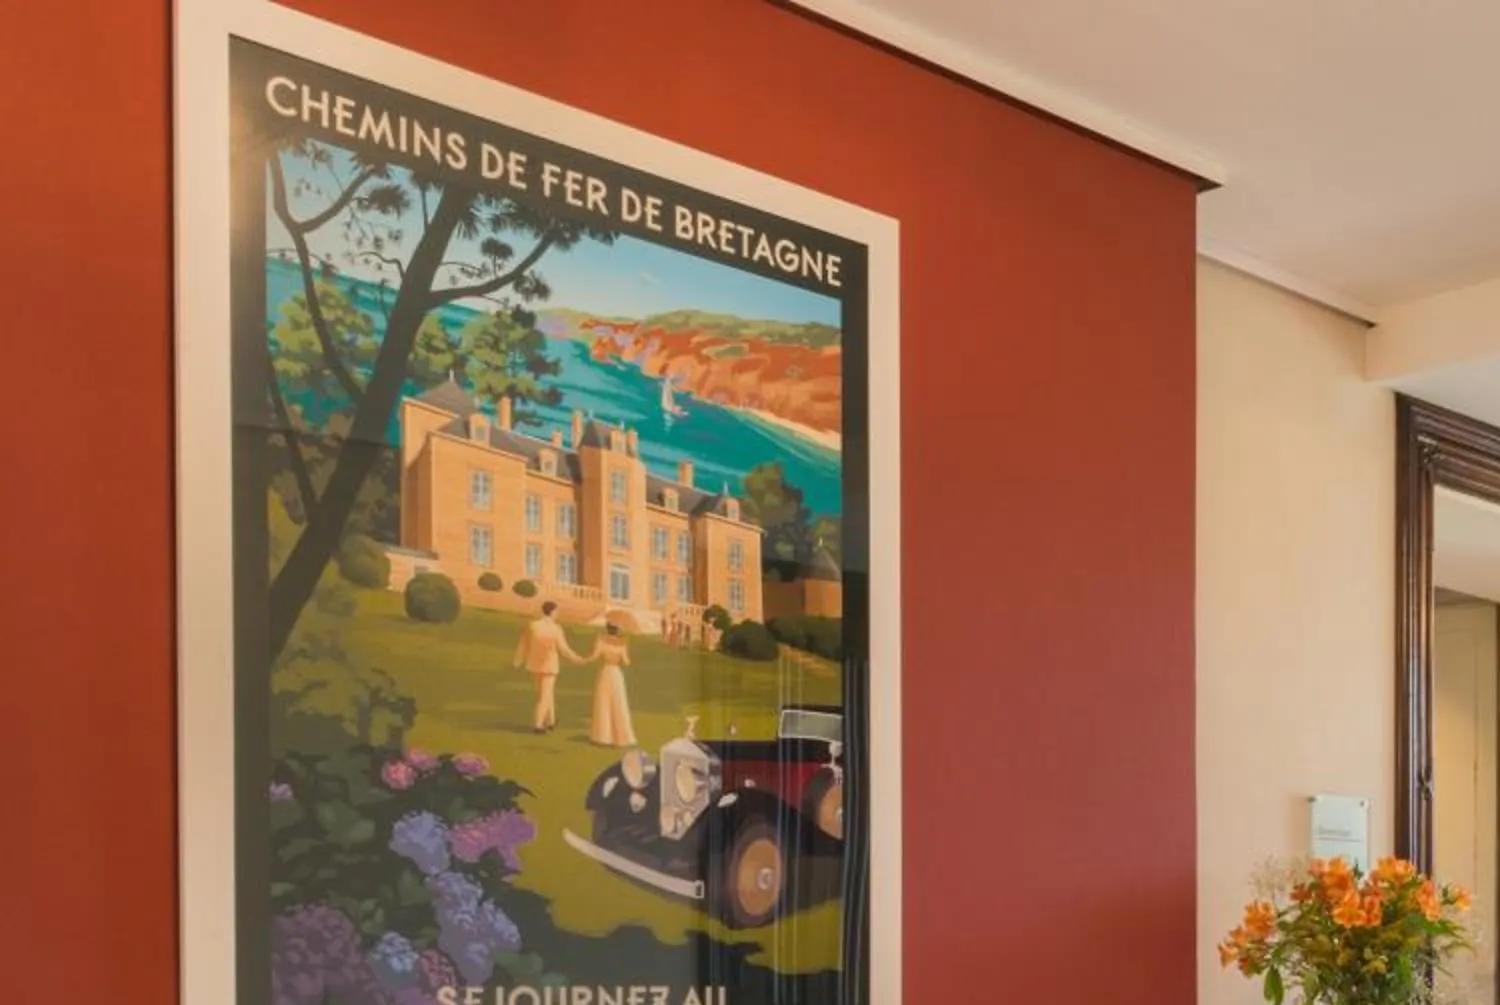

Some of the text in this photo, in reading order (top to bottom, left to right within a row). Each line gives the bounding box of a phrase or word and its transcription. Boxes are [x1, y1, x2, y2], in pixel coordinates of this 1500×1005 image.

[264, 75, 842, 288] CHEMINS DE FER DE BRETAGNE
